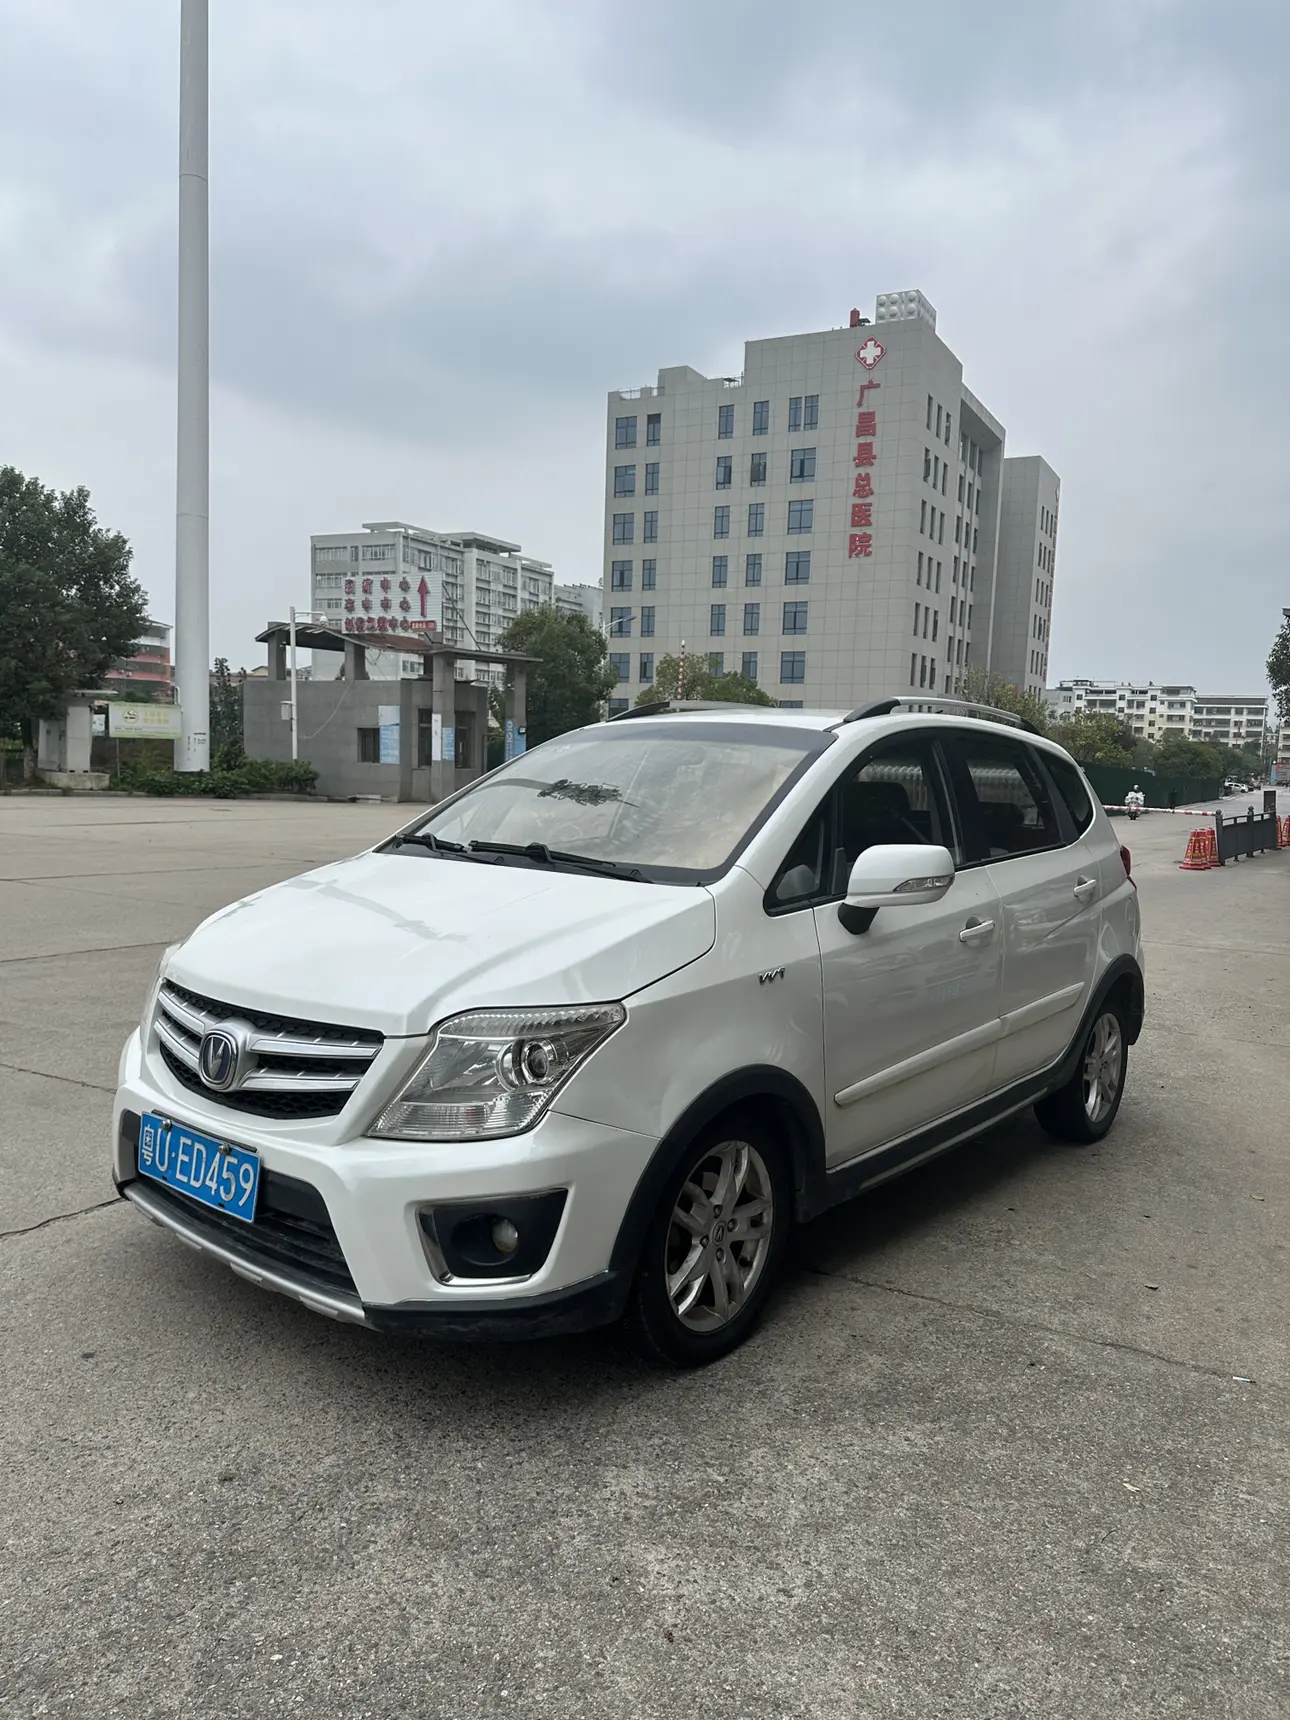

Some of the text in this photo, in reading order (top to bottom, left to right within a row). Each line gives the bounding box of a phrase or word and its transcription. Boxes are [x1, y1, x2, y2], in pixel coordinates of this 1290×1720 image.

[848, 378, 881, 559] 广昌县总医院
